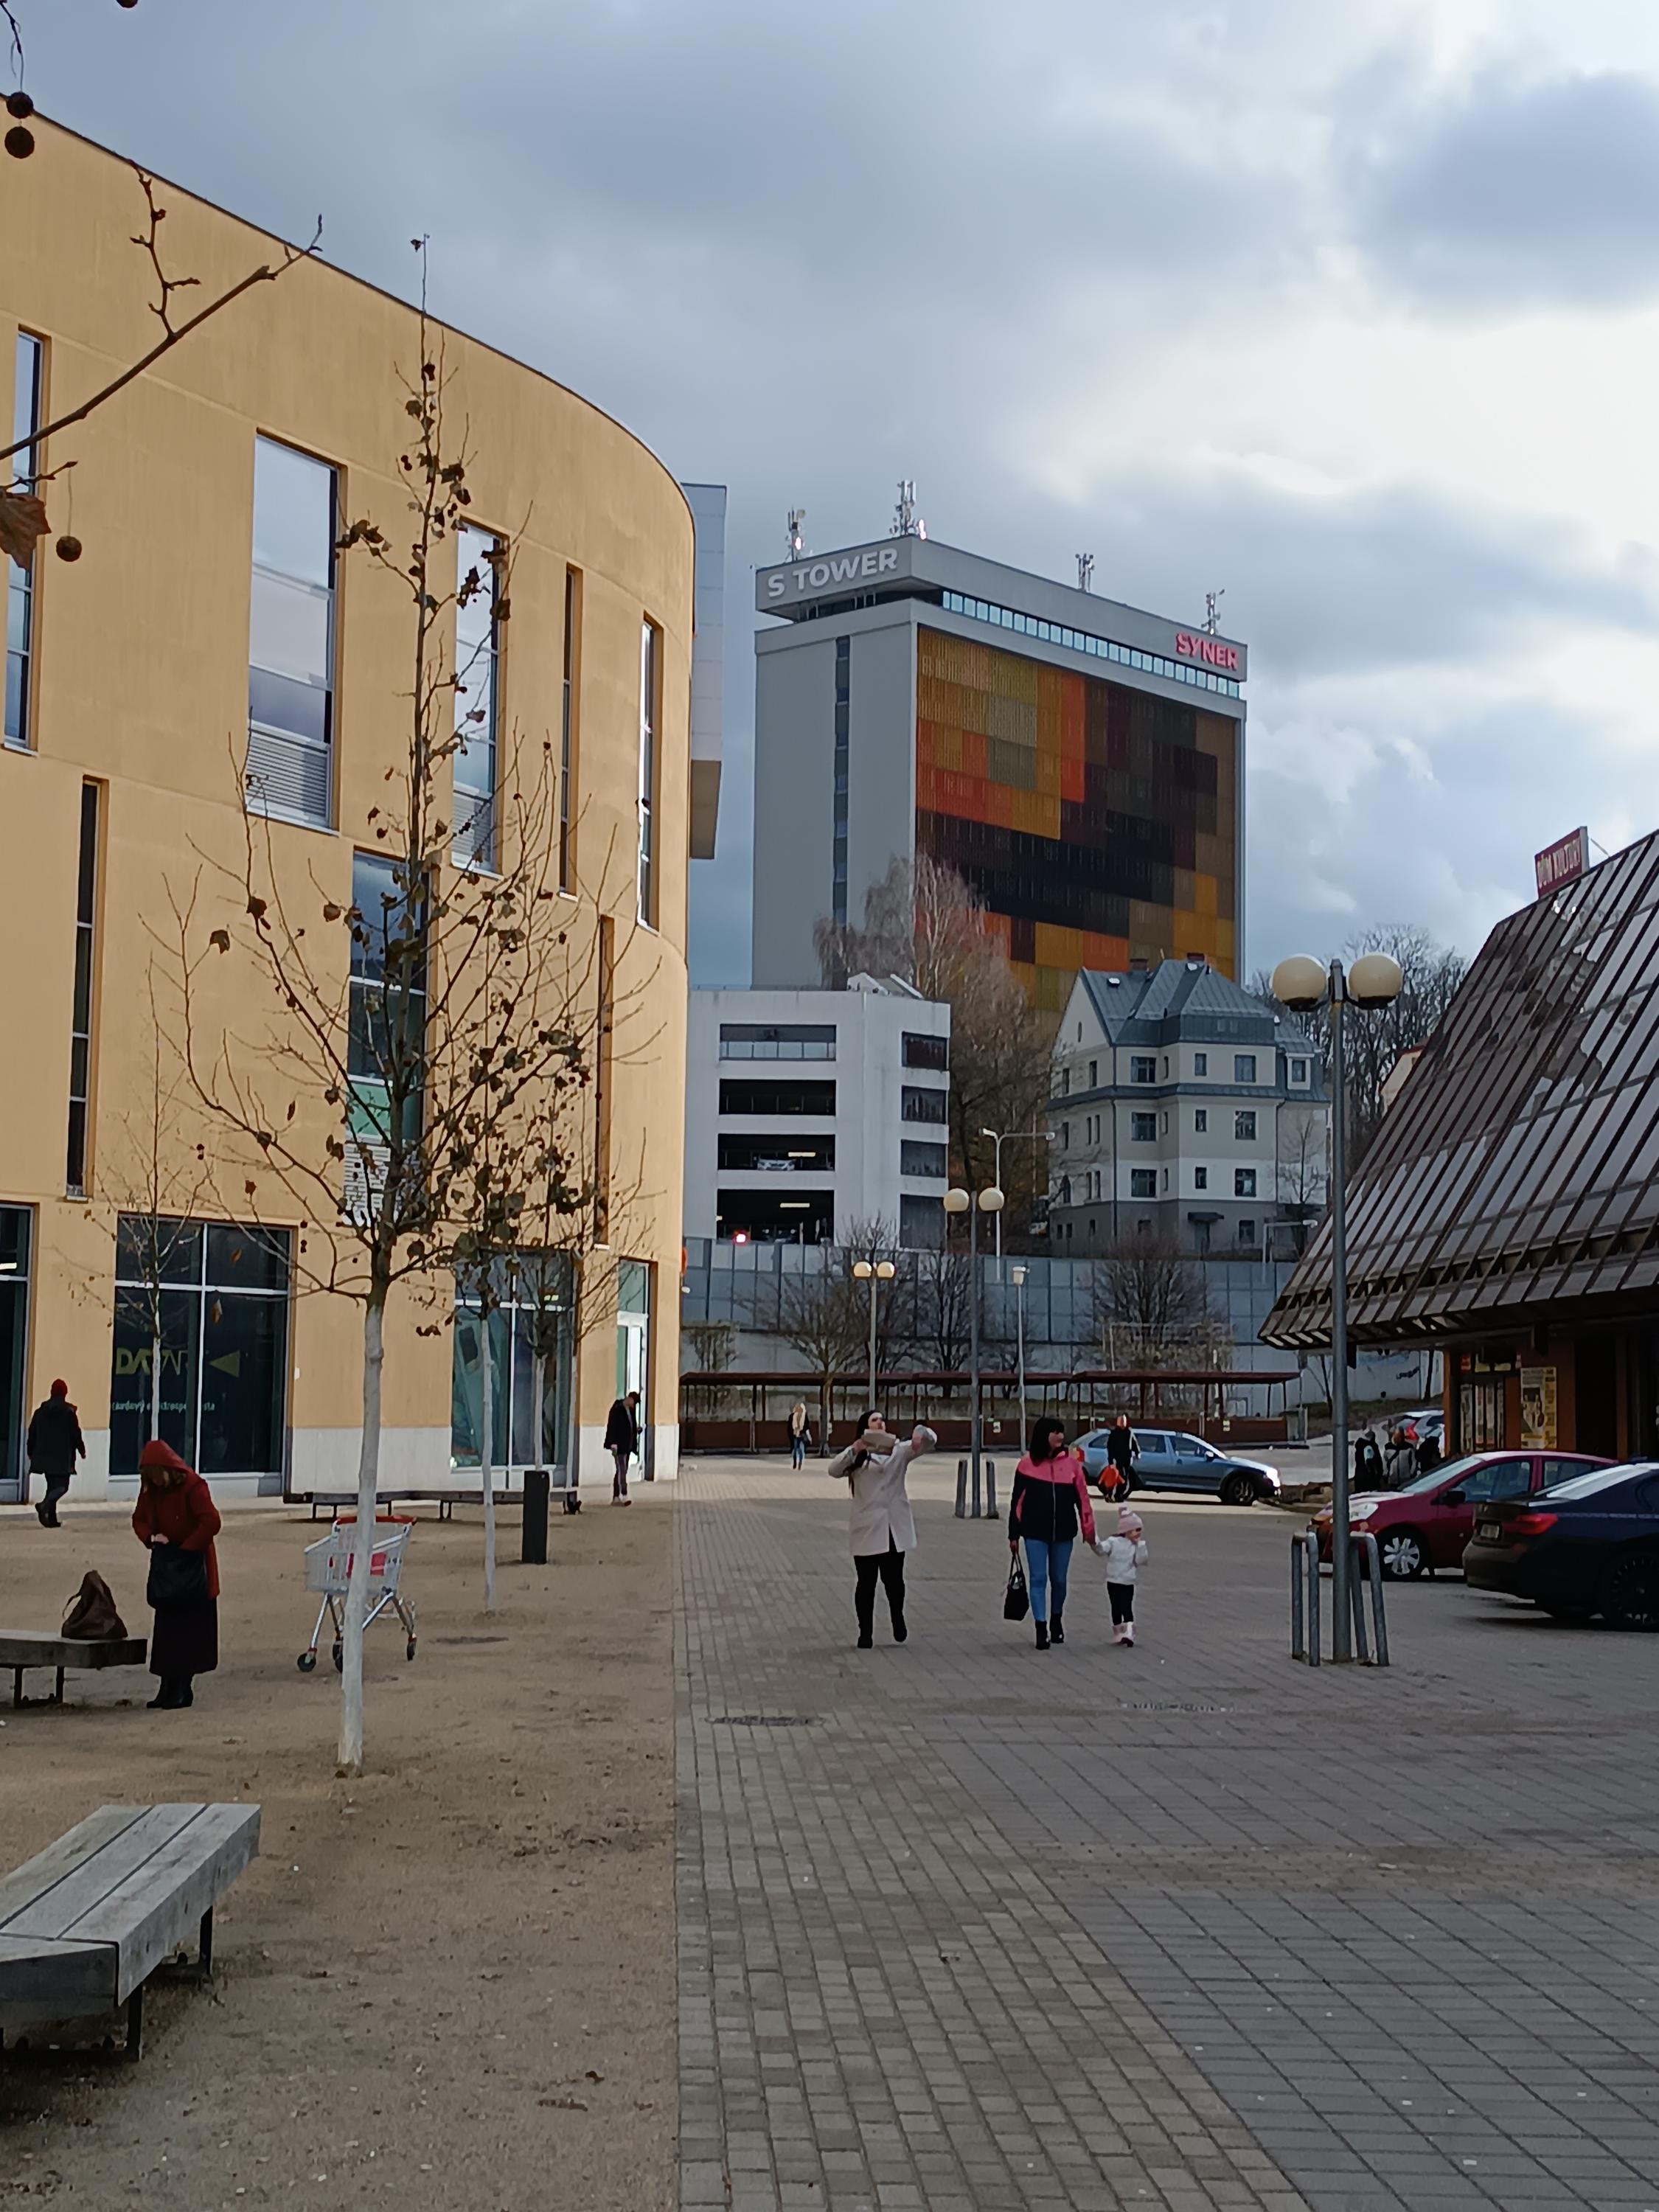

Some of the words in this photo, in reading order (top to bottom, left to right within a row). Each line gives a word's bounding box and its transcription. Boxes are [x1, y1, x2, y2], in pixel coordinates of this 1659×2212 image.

[768, 574, 785, 597] S
[793, 548, 897, 590] TOWER
[1175, 632, 1239, 671] SYNER
